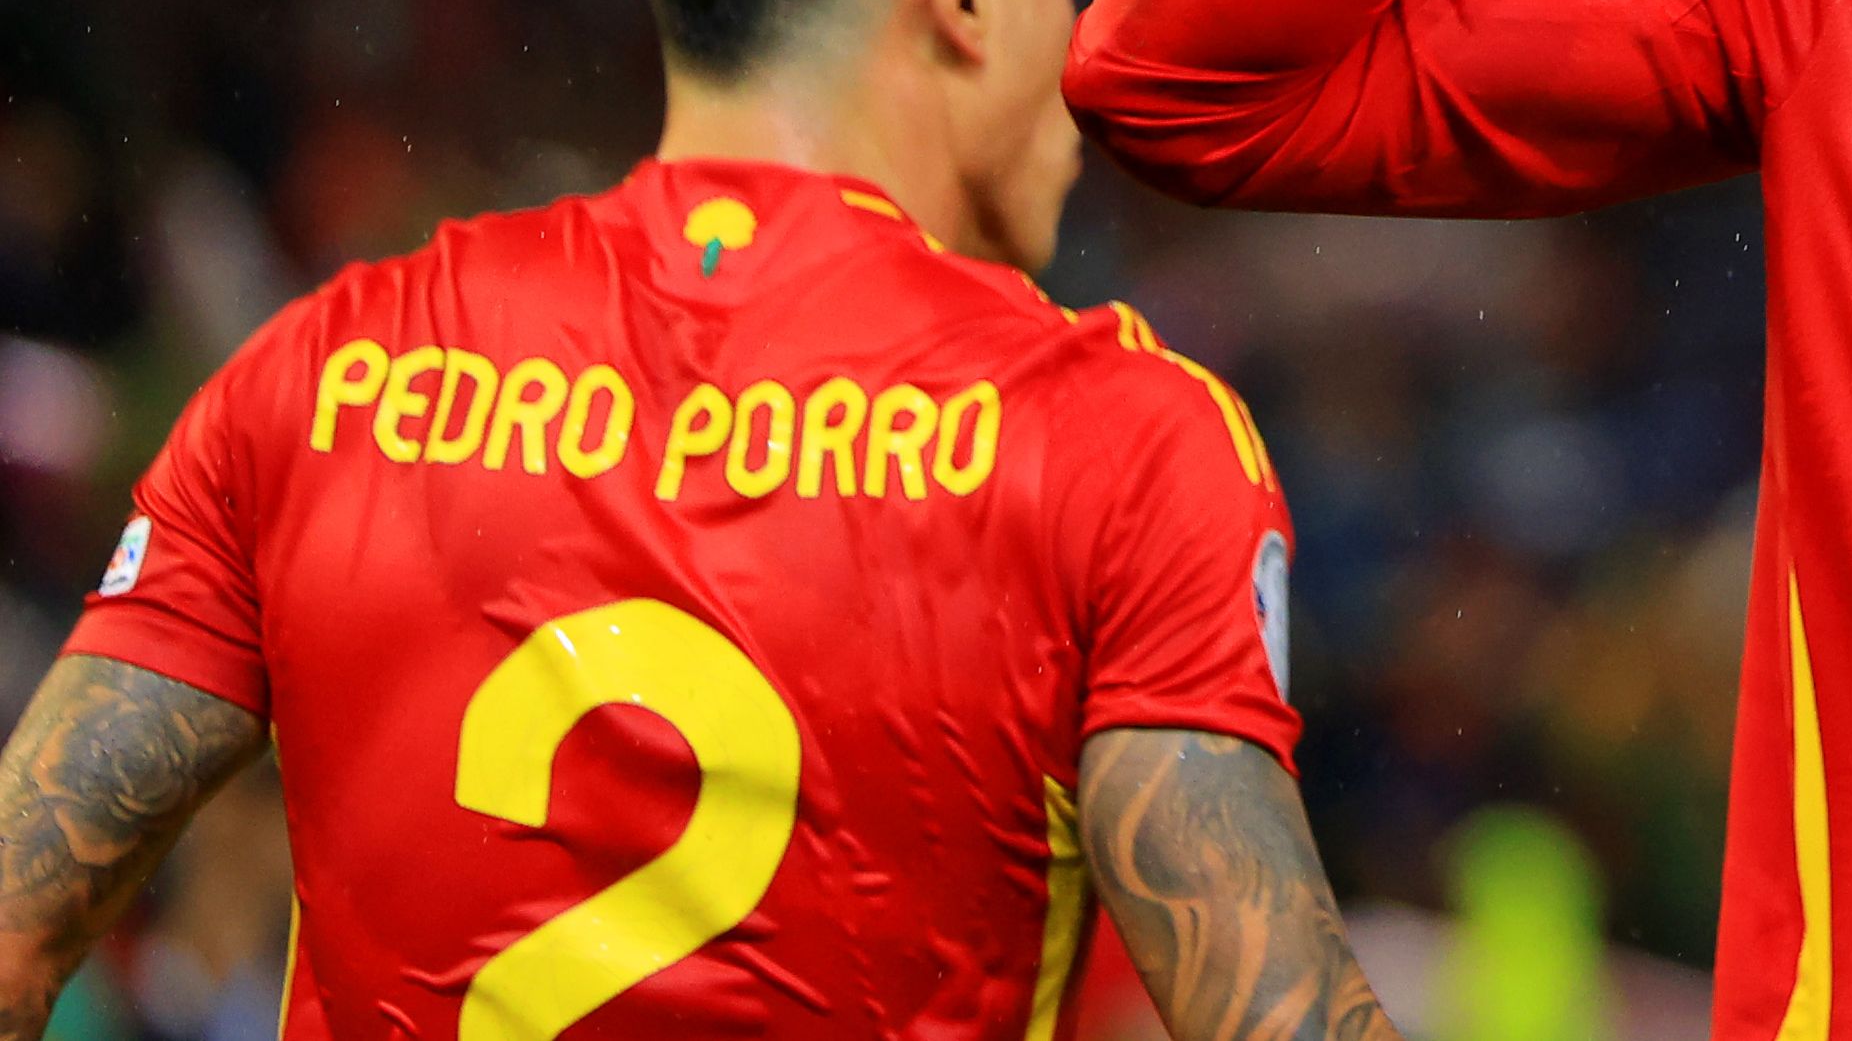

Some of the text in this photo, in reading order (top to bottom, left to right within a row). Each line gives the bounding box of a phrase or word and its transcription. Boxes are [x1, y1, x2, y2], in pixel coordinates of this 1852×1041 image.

[310, 338, 1001, 500] PEDRO PORRO
[455, 598, 802, 1041] 2
